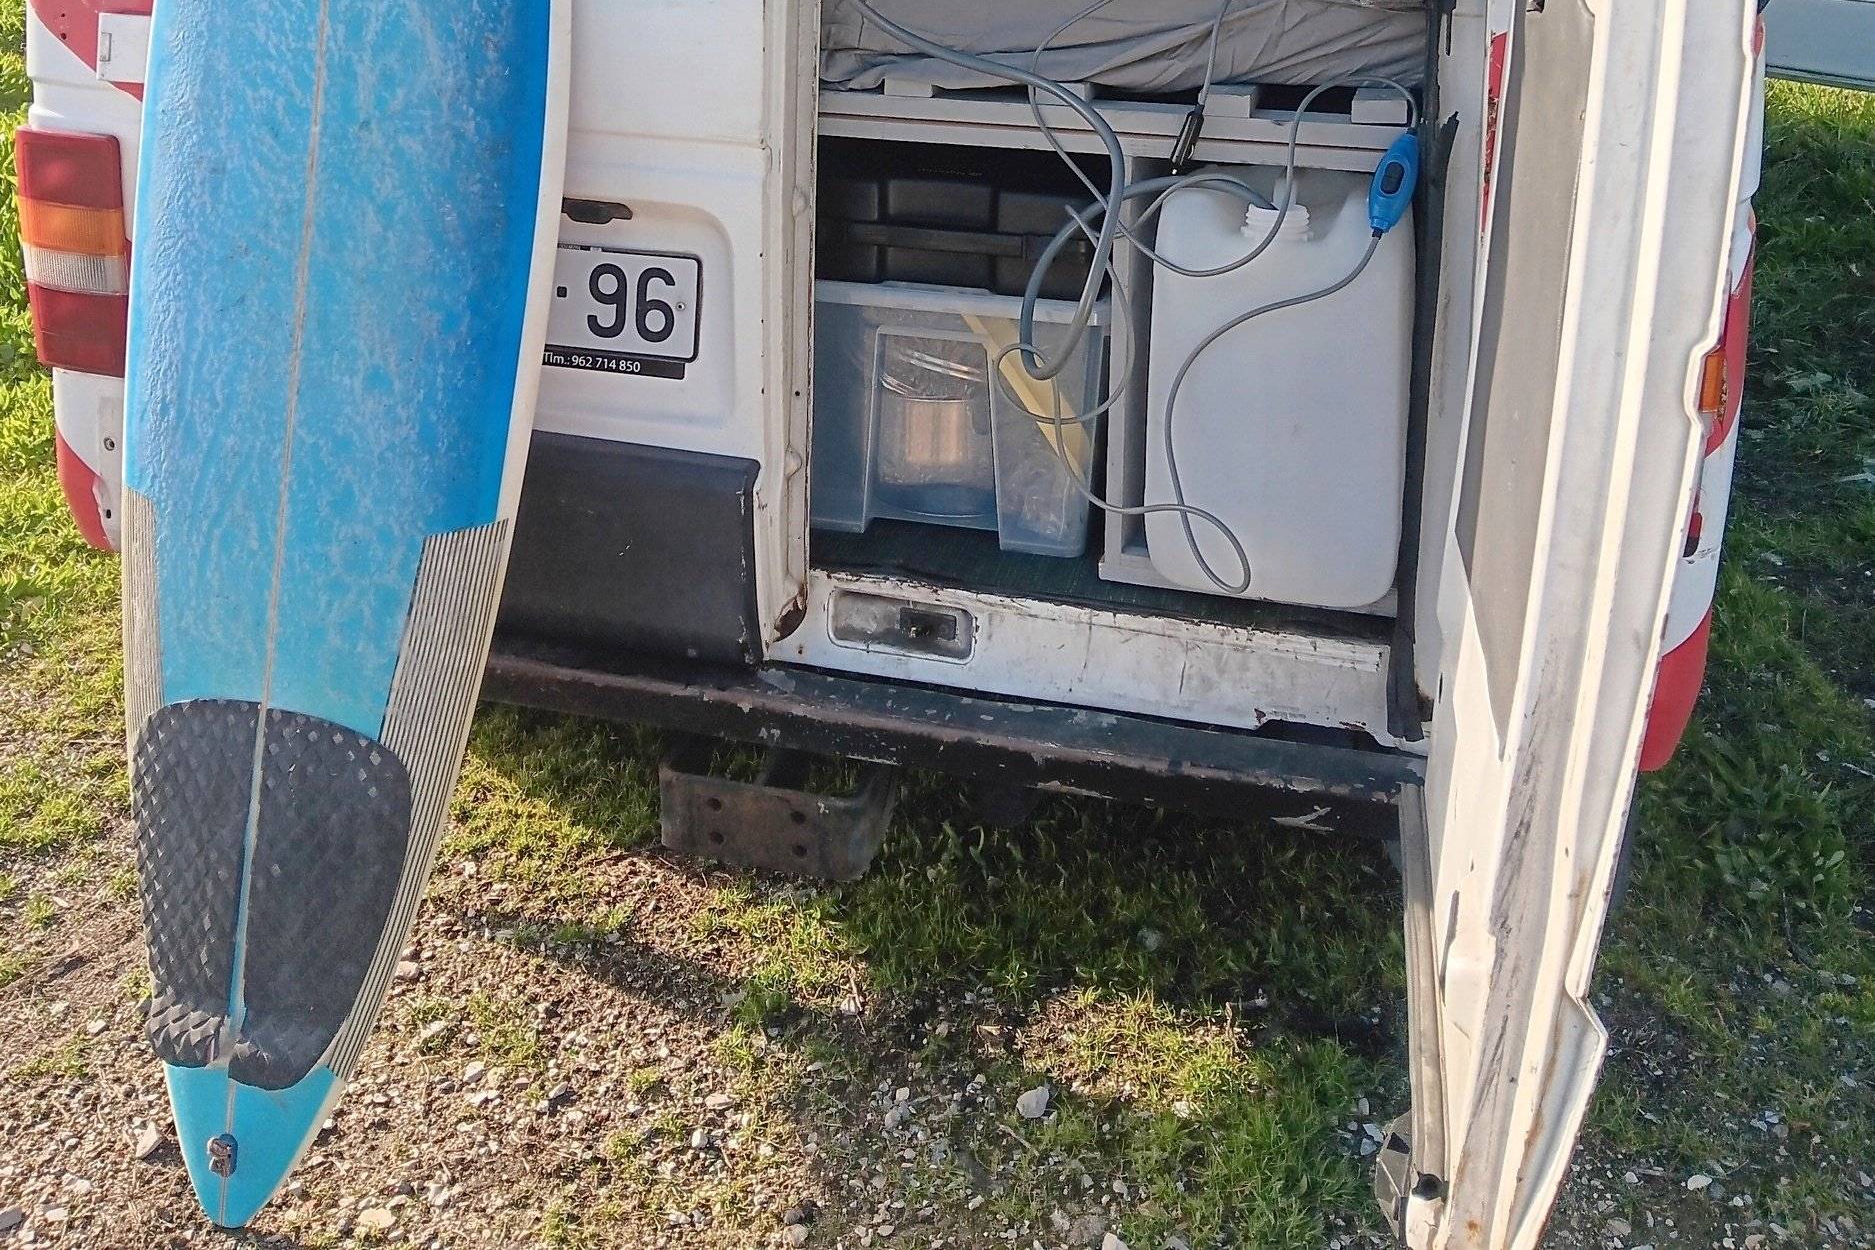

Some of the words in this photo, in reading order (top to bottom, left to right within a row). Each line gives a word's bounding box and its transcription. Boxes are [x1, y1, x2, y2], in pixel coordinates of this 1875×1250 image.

[587, 263, 676, 343] 96
[571, 354, 593, 367] 962
[595, 357, 616, 370] 714
[619, 359, 641, 373] 850
